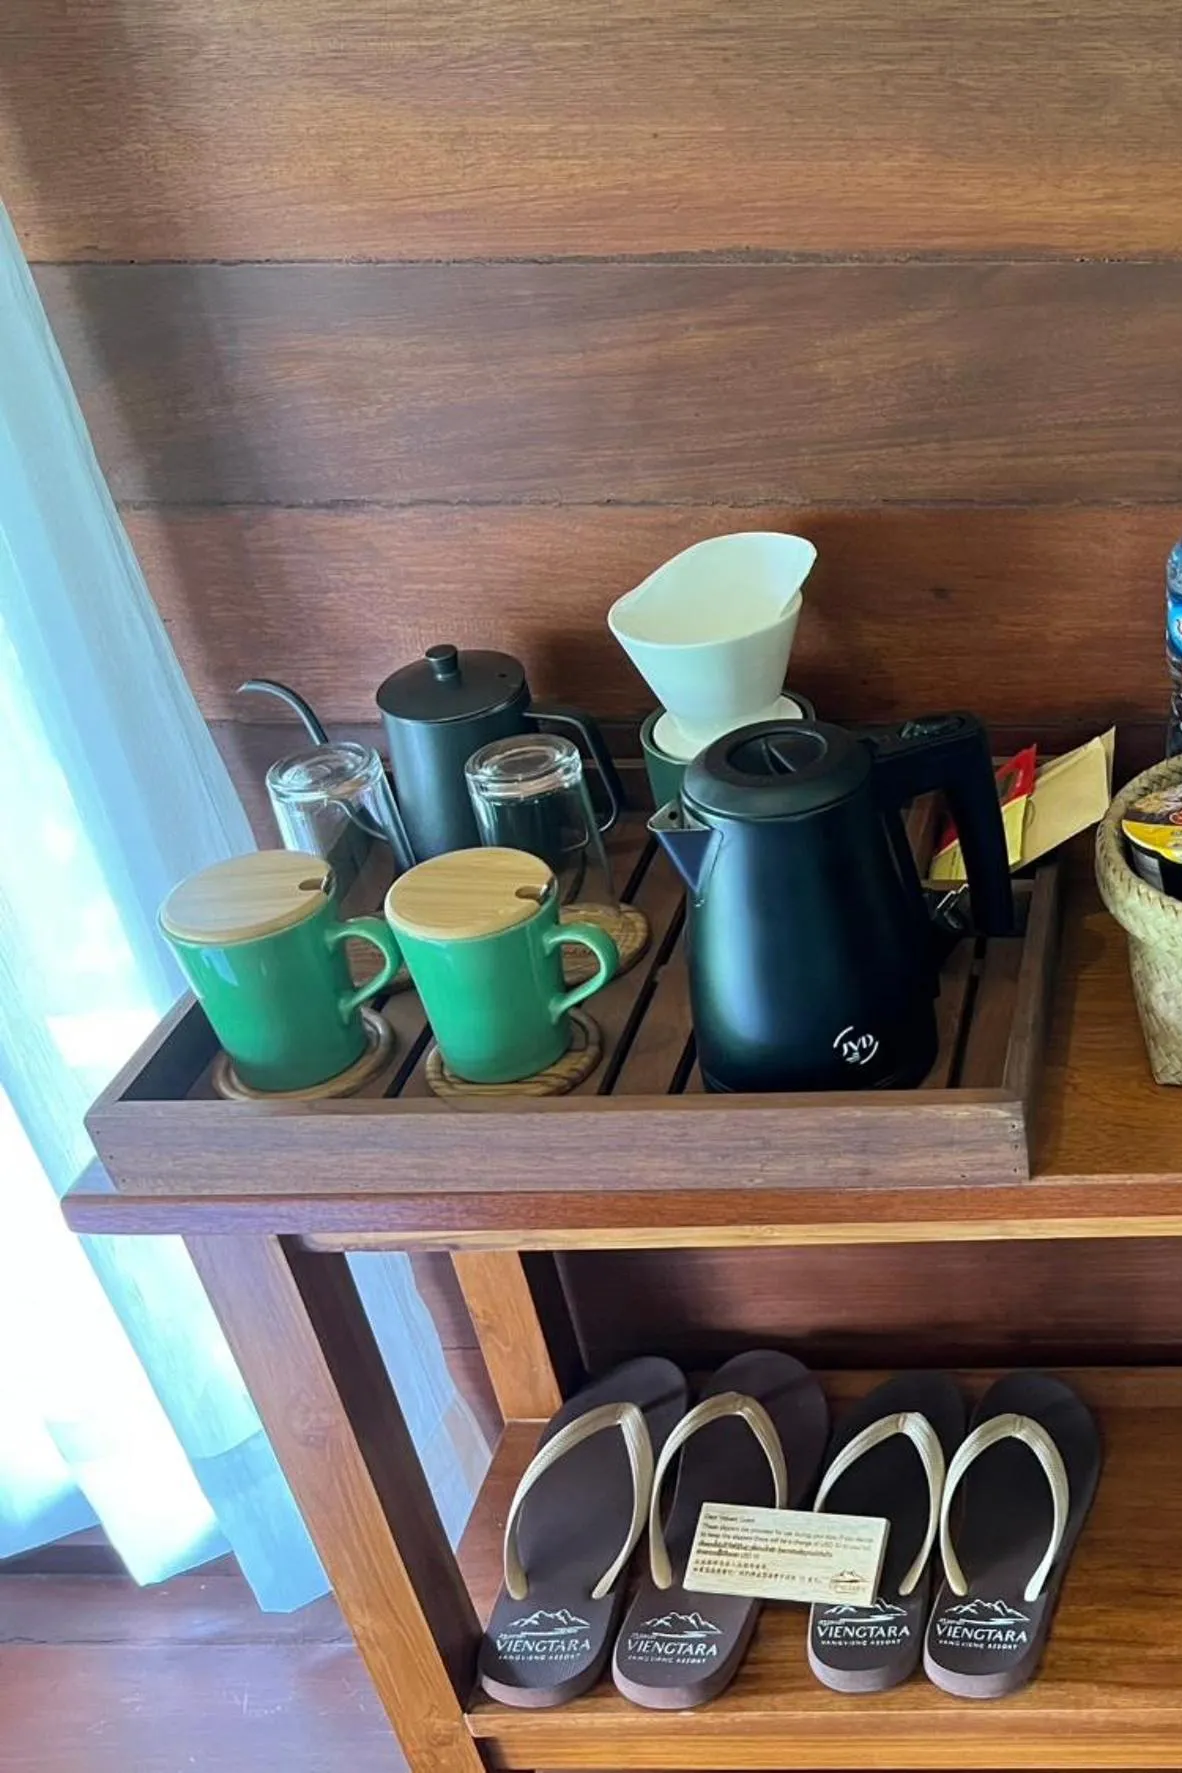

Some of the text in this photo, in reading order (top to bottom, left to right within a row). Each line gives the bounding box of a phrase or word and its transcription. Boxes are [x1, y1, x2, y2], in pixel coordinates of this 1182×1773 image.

[842, 1033, 874, 1057] JVD
[816, 1624, 911, 1639] VIENGTARA
[936, 1622, 1028, 1642] VIENGTARA
[495, 1638, 591, 1652] VIENGTARA
[626, 1638, 718, 1656] VIENGTARA
[870, 1638, 901, 1646] RESORT
[987, 1642, 1018, 1650] RESORT
[549, 1652, 581, 1660] RESORT
[675, 1657, 707, 1665] RESORT
